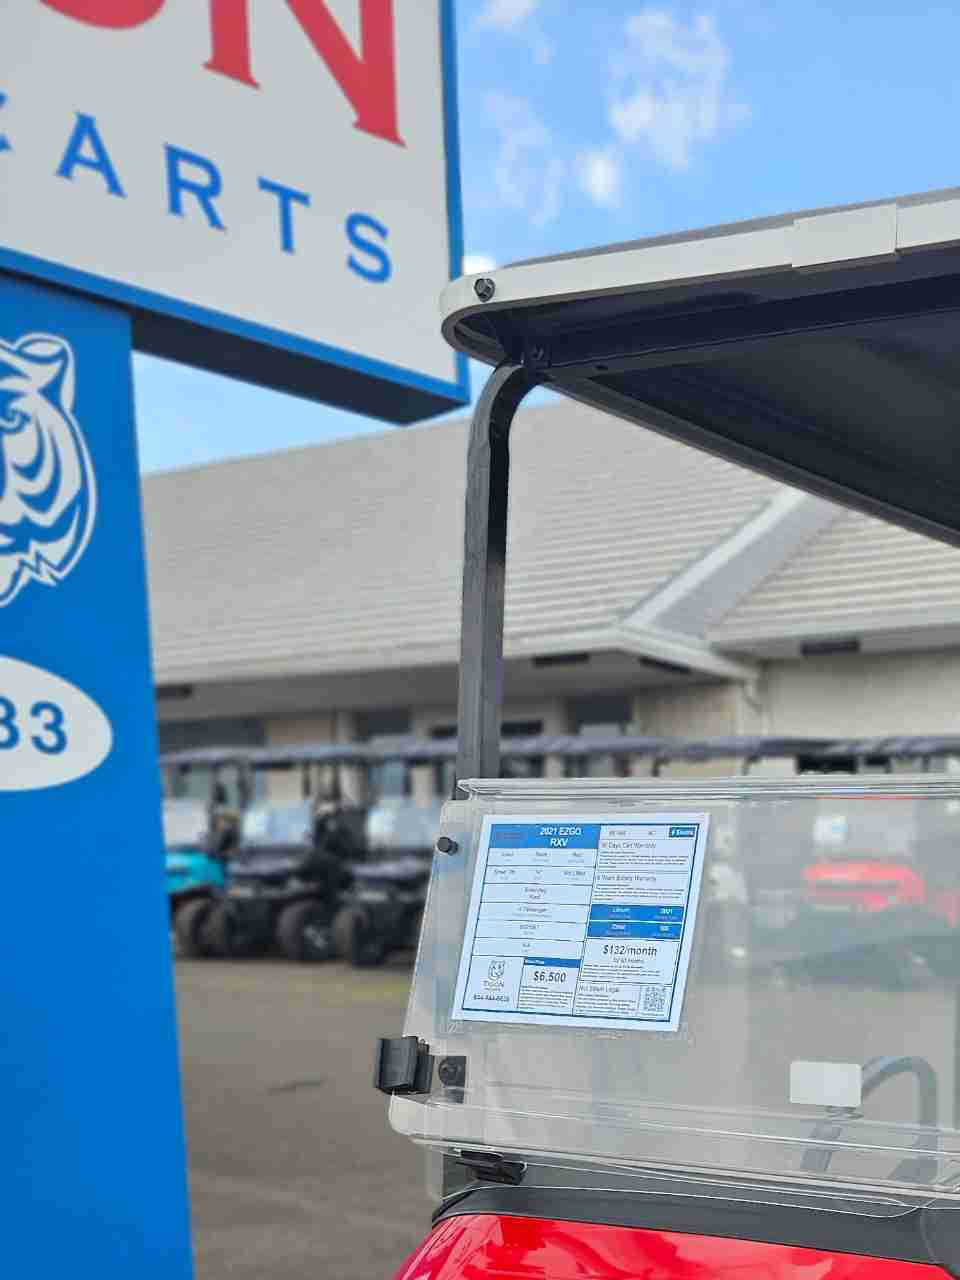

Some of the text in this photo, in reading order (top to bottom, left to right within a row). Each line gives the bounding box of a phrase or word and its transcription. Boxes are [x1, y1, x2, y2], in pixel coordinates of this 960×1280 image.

[0, 91, 393, 284] ARTS
[540, 826, 582, 837] 2021 EZGO
[550, 838, 568, 848] RXV
[603, 944, 657, 956] $132/month
[533, 970, 567, 983] $6,500
